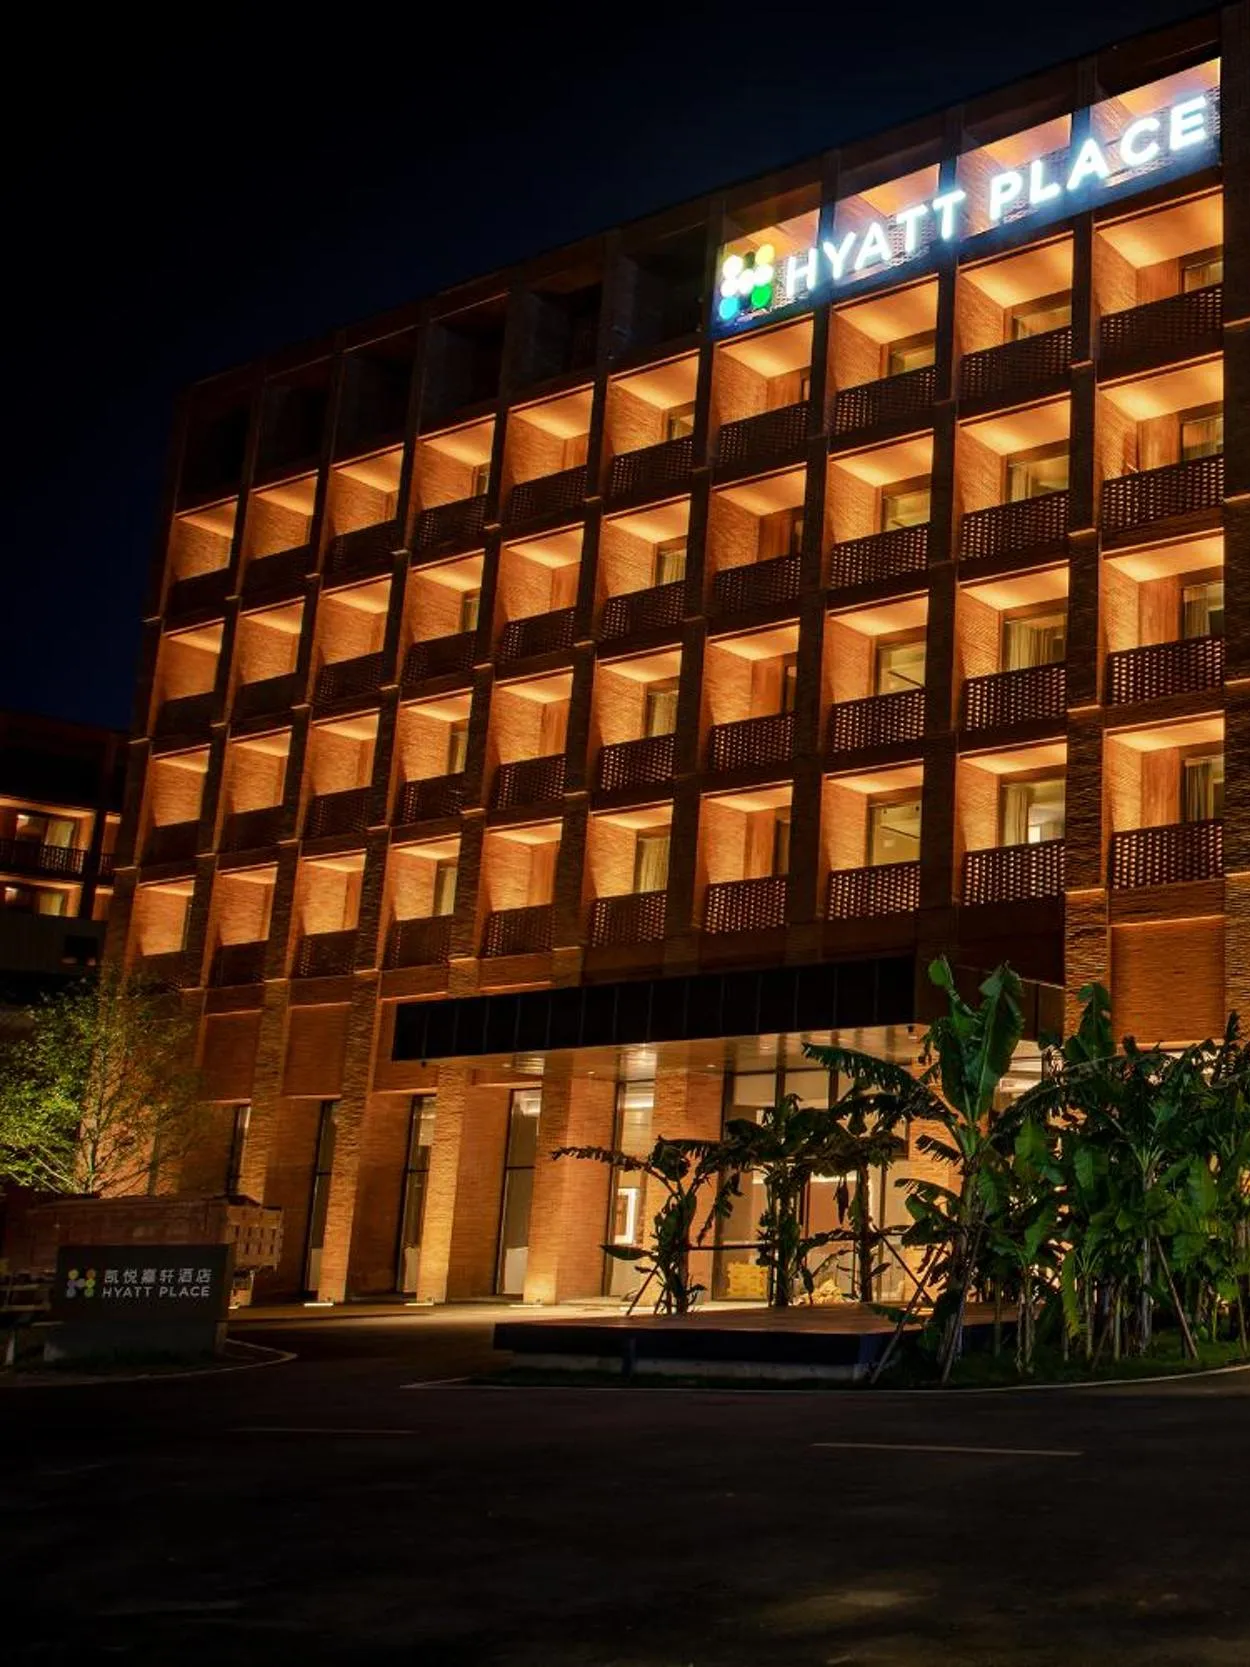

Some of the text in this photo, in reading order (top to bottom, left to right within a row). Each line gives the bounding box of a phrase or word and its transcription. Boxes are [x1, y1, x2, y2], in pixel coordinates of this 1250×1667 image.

[784, 95, 1208, 299] HYATT PLACE
[104, 1268, 212, 1283] 凯悦嘉轩酒店
[103, 1286, 210, 1298] HYATT PLACE
